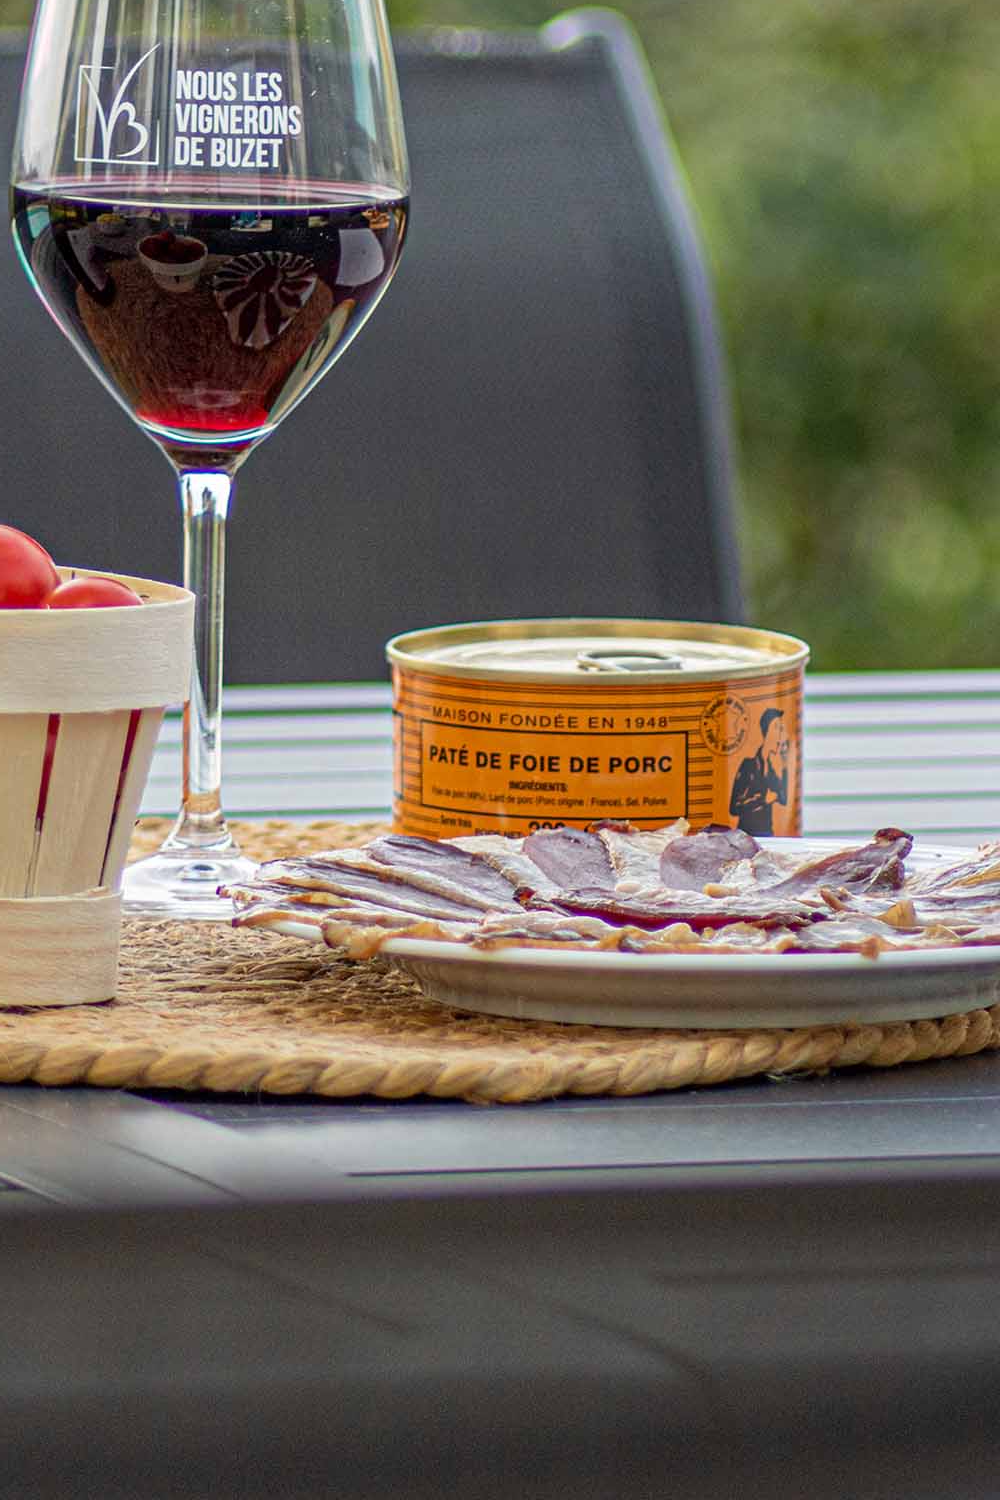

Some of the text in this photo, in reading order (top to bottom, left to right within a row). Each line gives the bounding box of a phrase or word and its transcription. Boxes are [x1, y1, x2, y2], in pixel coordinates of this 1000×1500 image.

[175, 70, 283, 102] NOUS LES
[175, 103, 302, 135] VIGNERONS
[174, 137, 283, 168] DE BUZET
[432, 706, 668, 729] MAISON FONDÉE EN 1948
[475, 751, 502, 770] DE
[509, 755, 561, 772] FOIE
[569, 756, 600, 773] DE
[609, 756, 673, 773] PORC
